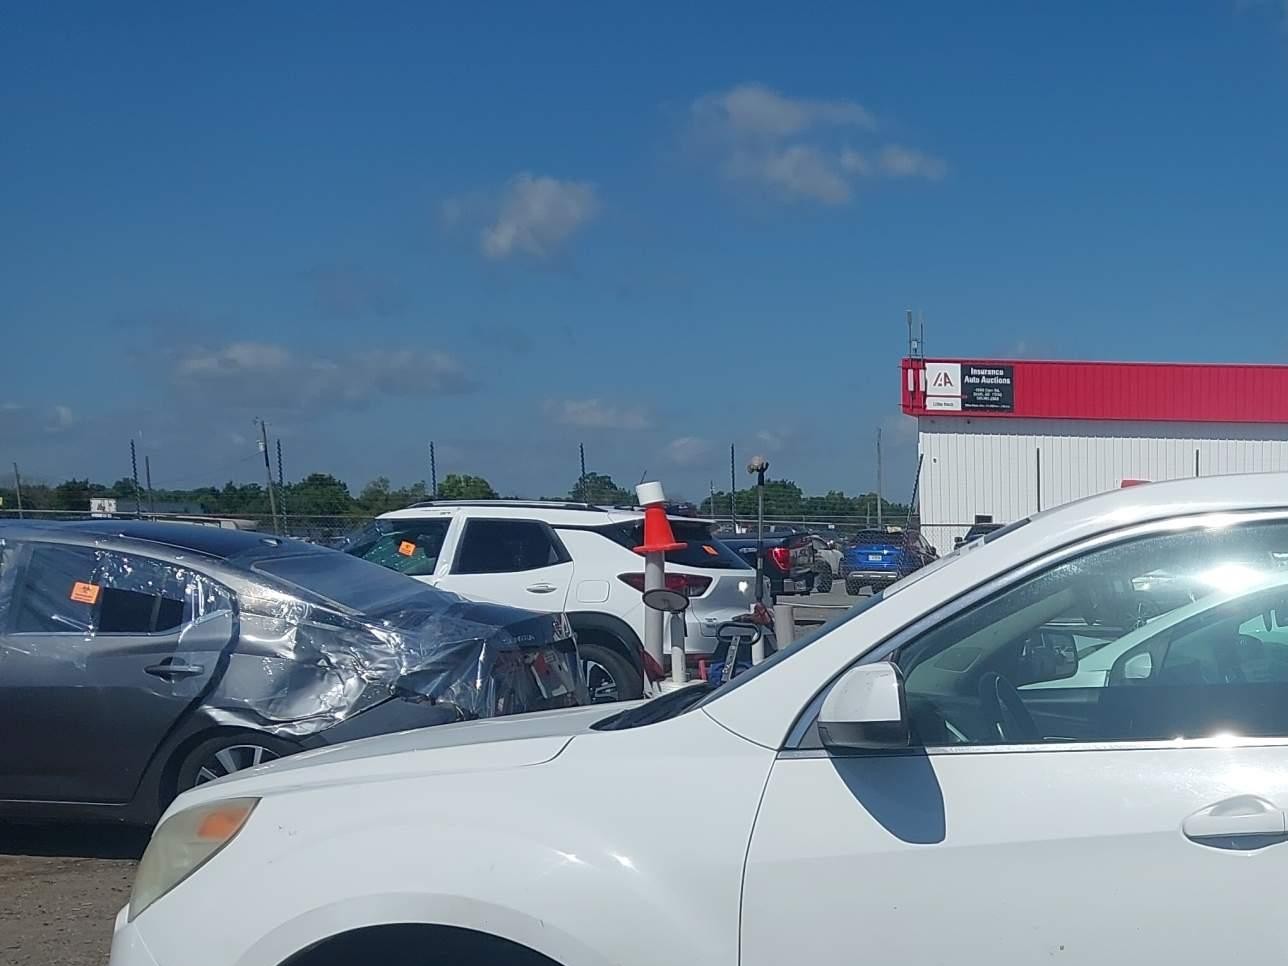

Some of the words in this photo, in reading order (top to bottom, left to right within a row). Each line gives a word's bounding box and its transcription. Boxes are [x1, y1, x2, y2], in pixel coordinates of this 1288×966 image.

[970, 367, 1004, 375] Insurance
[964, 375, 980, 383] Auto
[981, 376, 1010, 384] Auctions
